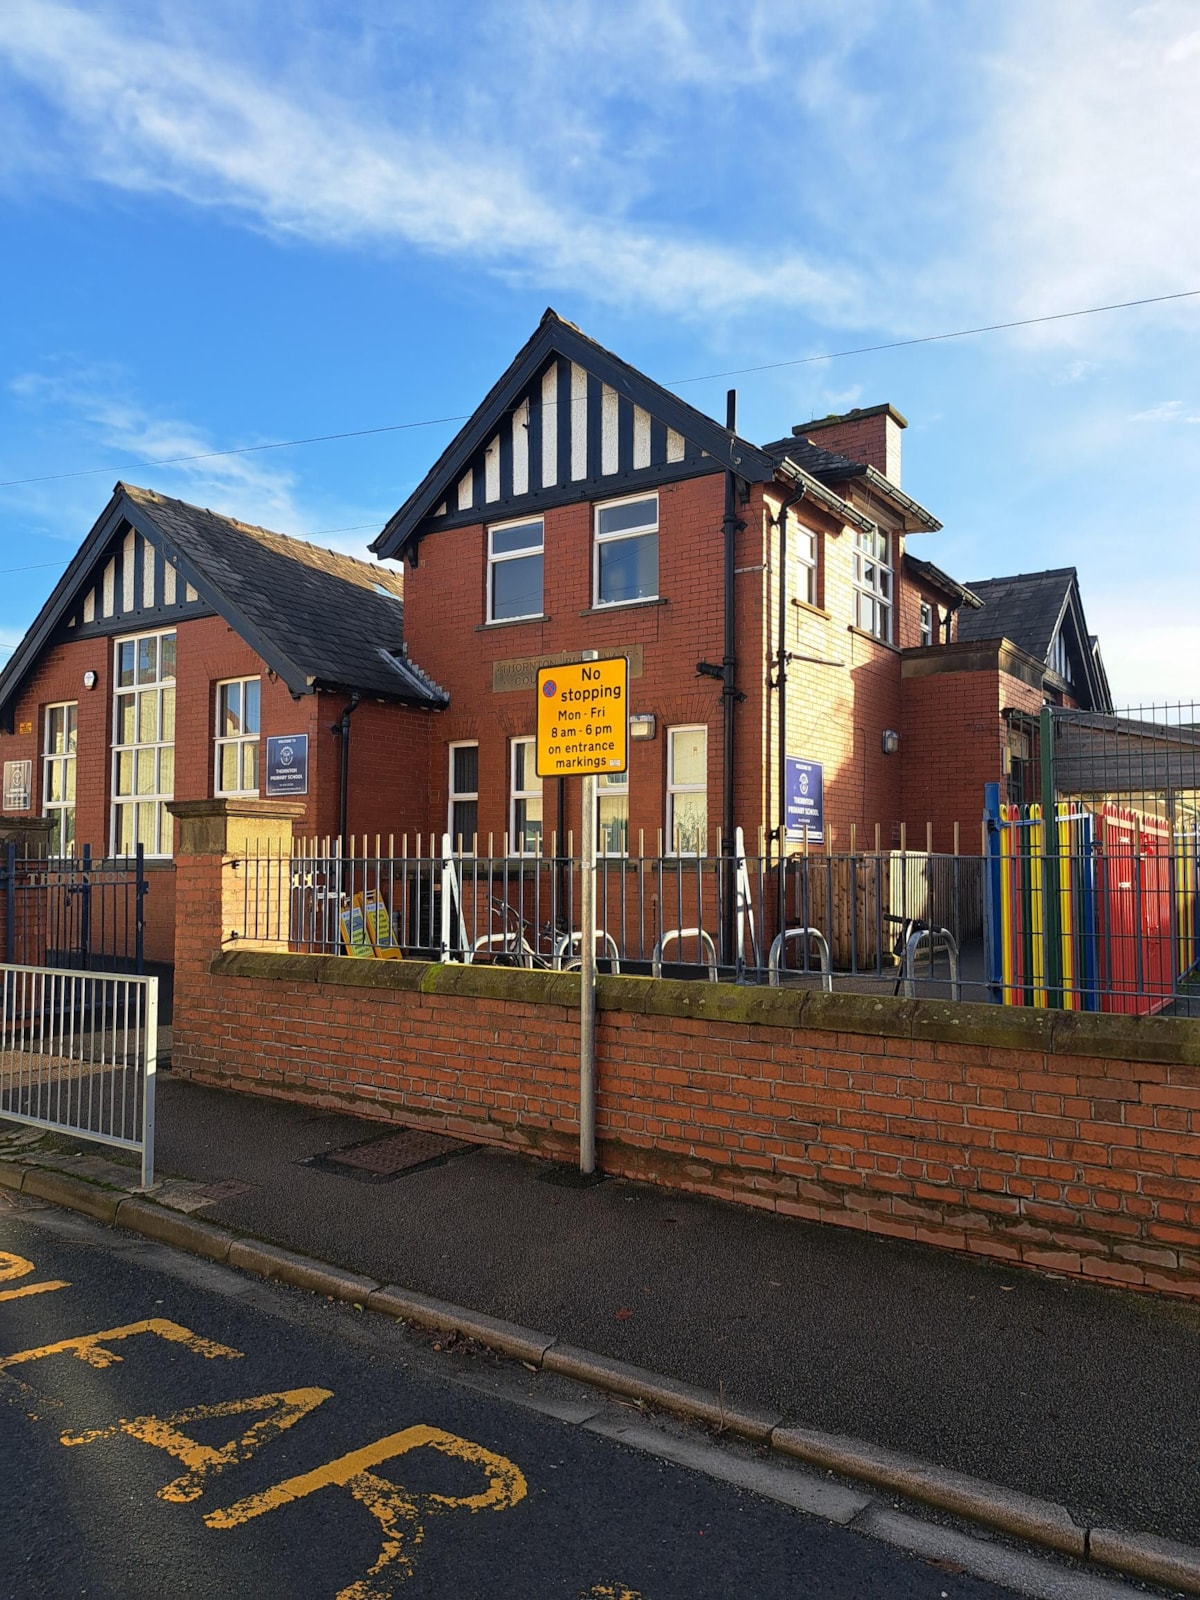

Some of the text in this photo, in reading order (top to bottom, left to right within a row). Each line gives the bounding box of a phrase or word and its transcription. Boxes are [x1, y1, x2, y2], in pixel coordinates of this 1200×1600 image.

[514, 675, 537, 686] COU
[581, 667, 601, 681] No
[561, 684, 621, 702] stopping
[558, 710, 581, 721] Mon
[590, 706, 605, 718] Fri
[548, 742, 614, 754] on entrance
[556, 756, 607, 768] markings
[805, 808, 819, 816] SCHOOL
[27, 871, 128, 886] THORNTON
